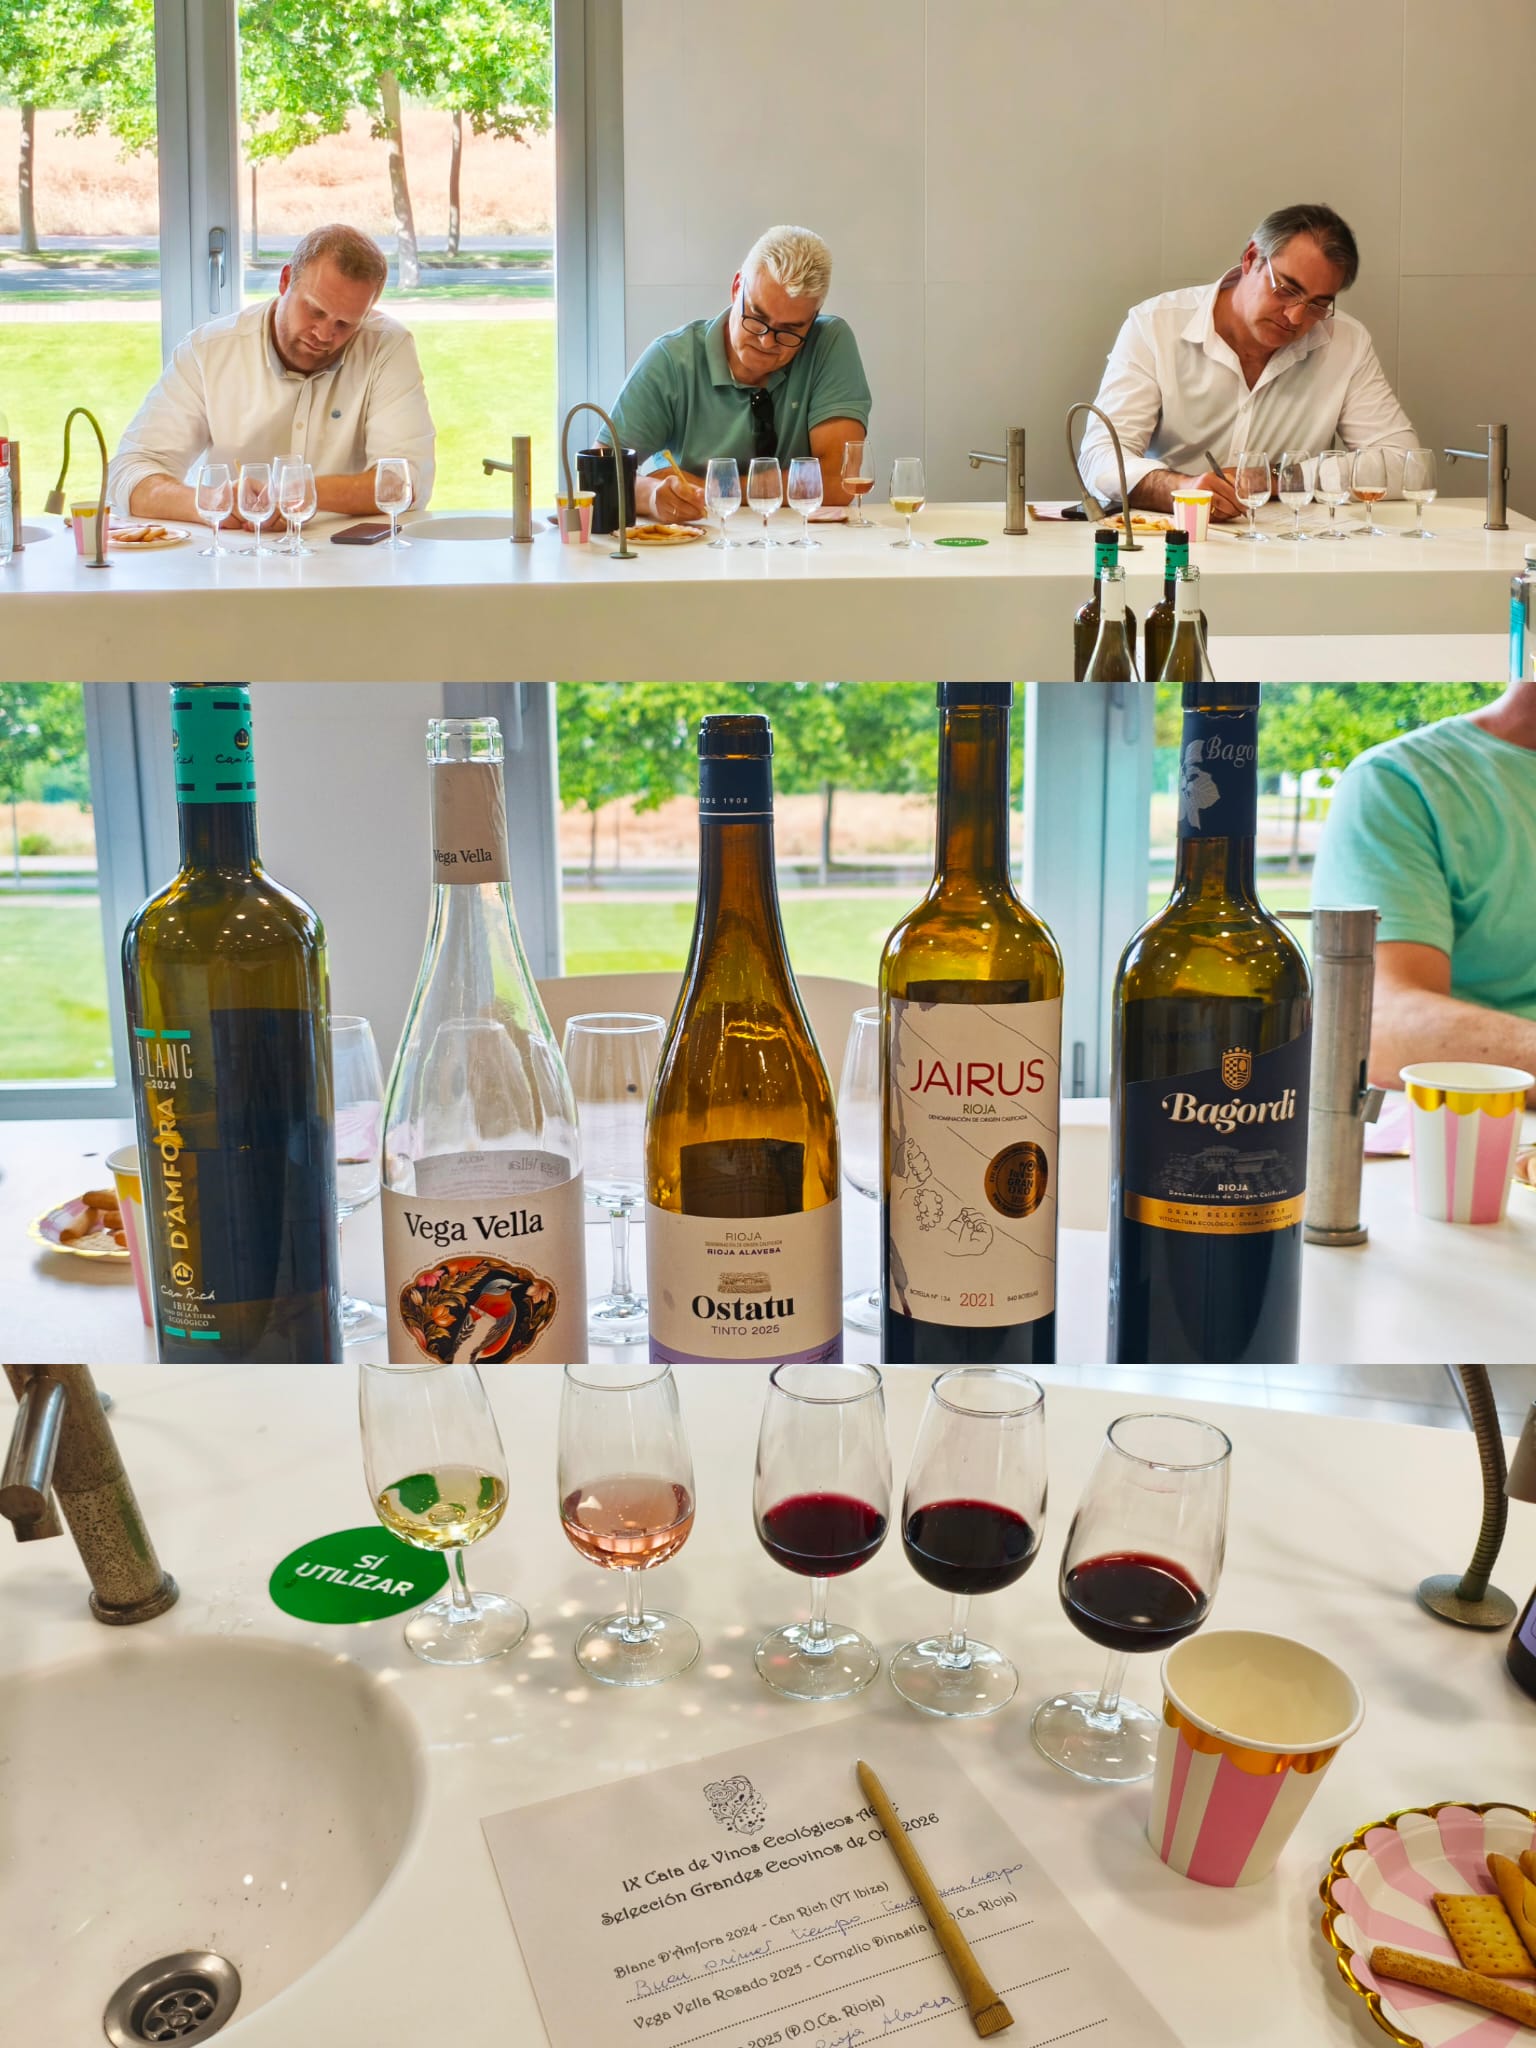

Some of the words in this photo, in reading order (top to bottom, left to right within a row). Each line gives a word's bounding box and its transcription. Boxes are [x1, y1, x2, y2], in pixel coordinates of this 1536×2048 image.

[433, 848, 457, 866] Vega
[460, 848, 492, 863] Vella
[136, 1040, 193, 1079] BLANC
[151, 1080, 177, 1090] 2024
[910, 1058, 1045, 1097] JAIRUS
[963, 1103, 996, 1115] RIOJA
[1161, 1088, 1297, 1134] Bagordi
[1217, 1184, 1248, 1192] RIOJA
[1167, 1208, 1199, 1217] GRAN
[1207, 1211, 1259, 1219] RESERVA
[404, 1211, 468, 1247] Vega
[473, 1209, 544, 1240] Vella
[725, 1232, 762, 1241] RIOJA
[707, 1248, 735, 1256] RIOJA
[739, 1247, 781, 1256] ALAVESA
[173, 1301, 200, 1312] IBIZA
[691, 1295, 796, 1321] Ostatu
[959, 1292, 995, 1307] 2021
[712, 1325, 747, 1336] TINTO
[752, 1324, 780, 1335] 2025
[353, 1555, 390, 1570] SÍ
[295, 1562, 415, 1597] UTILIZAR
[622, 1876, 642, 1892] IX
[645, 1866, 685, 1885] Cata
[688, 1857, 710, 1872] de
[711, 1843, 760, 1863] Vinos
[763, 1814, 854, 1848] Ecológicos
[601, 1891, 688, 1926] Selección
[690, 1867, 764, 1897] Grandes
[765, 1842, 843, 1873] Ecovinos
[846, 1835, 868, 1849] de
[868, 1828, 888, 1842] Or
[901, 1812, 940, 1832] 2026
[613, 1957, 657, 1979] Blanc
[725, 1923, 758, 1942] 2024
[769, 1911, 795, 1926] Can
[796, 1901, 828, 1917] Rich
[830, 1890, 851, 1908] (VT
[853, 1881, 889, 1899] Ibiza)
[633, 2010, 672, 2029] Vega
[673, 1997, 711, 2016] Vella
[712, 1977, 768, 2002] Rosado
[770, 1963, 802, 1983] 2025
[813, 1943, 871, 1967] Cornelio
[871, 1923, 927, 1947] Dinastía
[978, 1891, 1017, 1912] Rioja)
[748, 2031, 782, 2048] 2025
[785, 2012, 842, 2040] (D.O.Ca.
[841, 1995, 885, 2018] Rioja)
